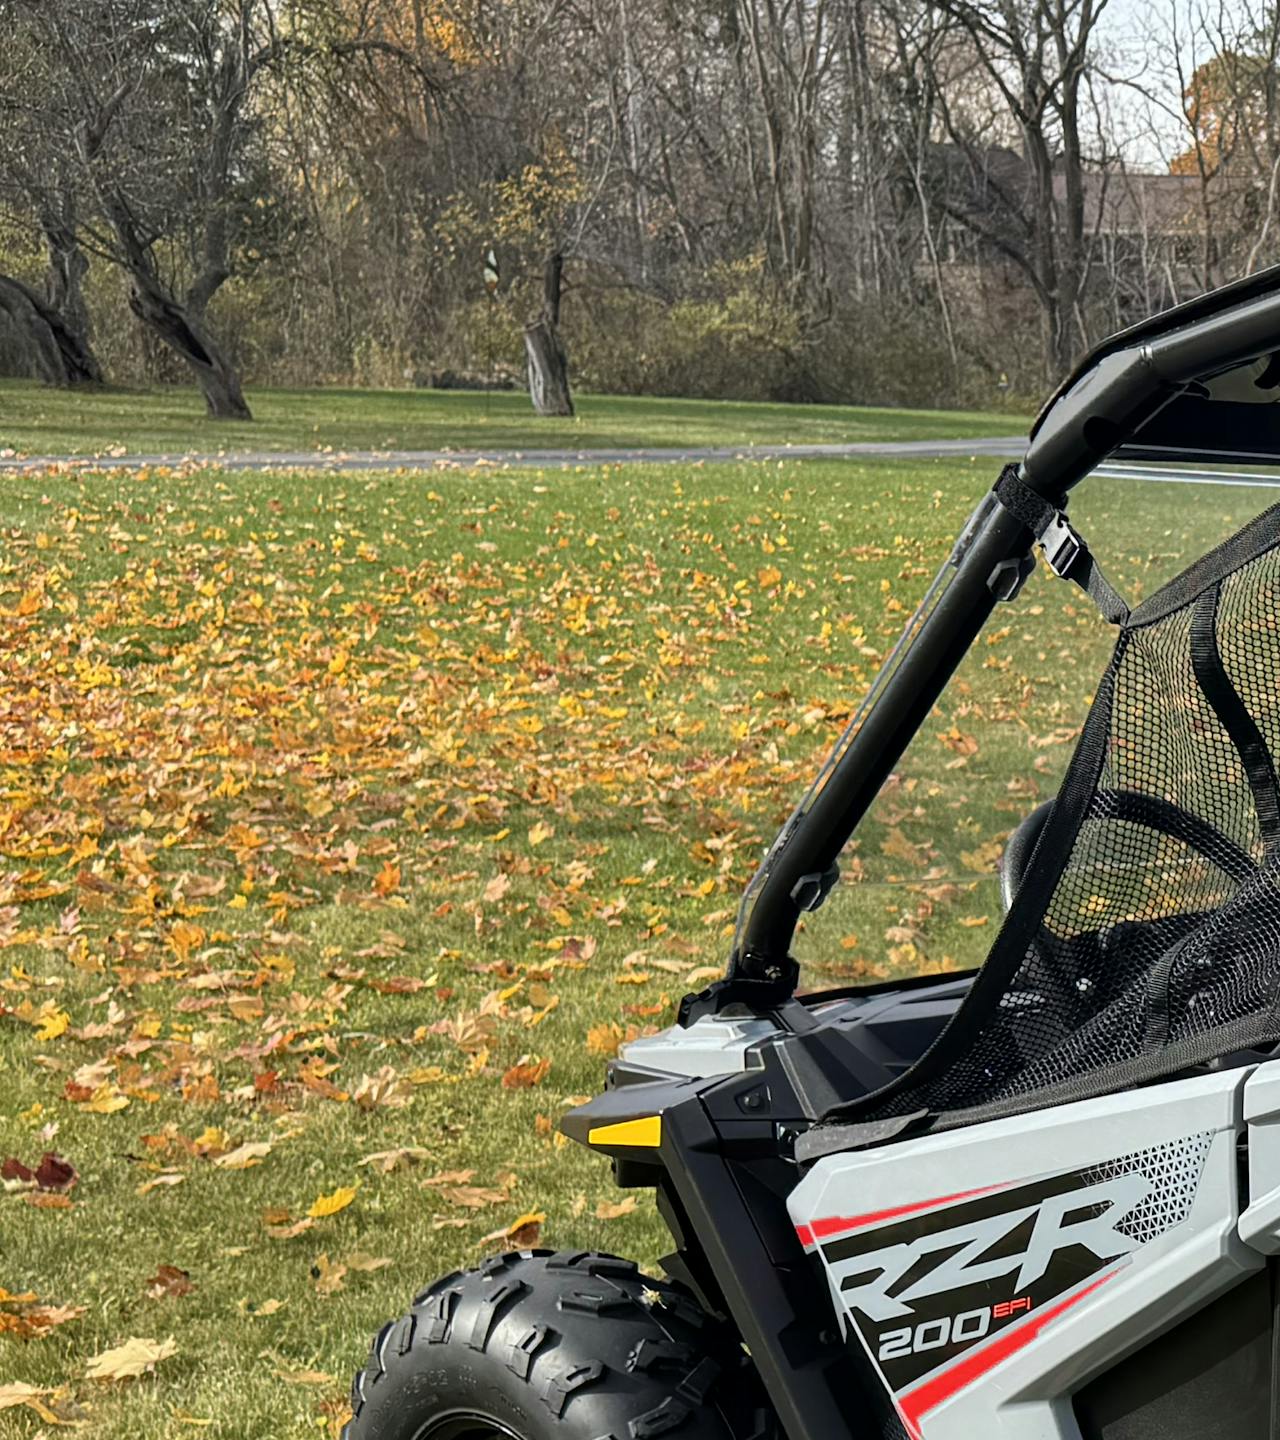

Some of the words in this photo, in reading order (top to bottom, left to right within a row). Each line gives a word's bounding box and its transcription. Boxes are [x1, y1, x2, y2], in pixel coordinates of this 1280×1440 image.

[826, 1172, 1155, 1342] RZR
[879, 1306, 992, 1362] 200
[993, 1297, 1032, 1319] EFI
